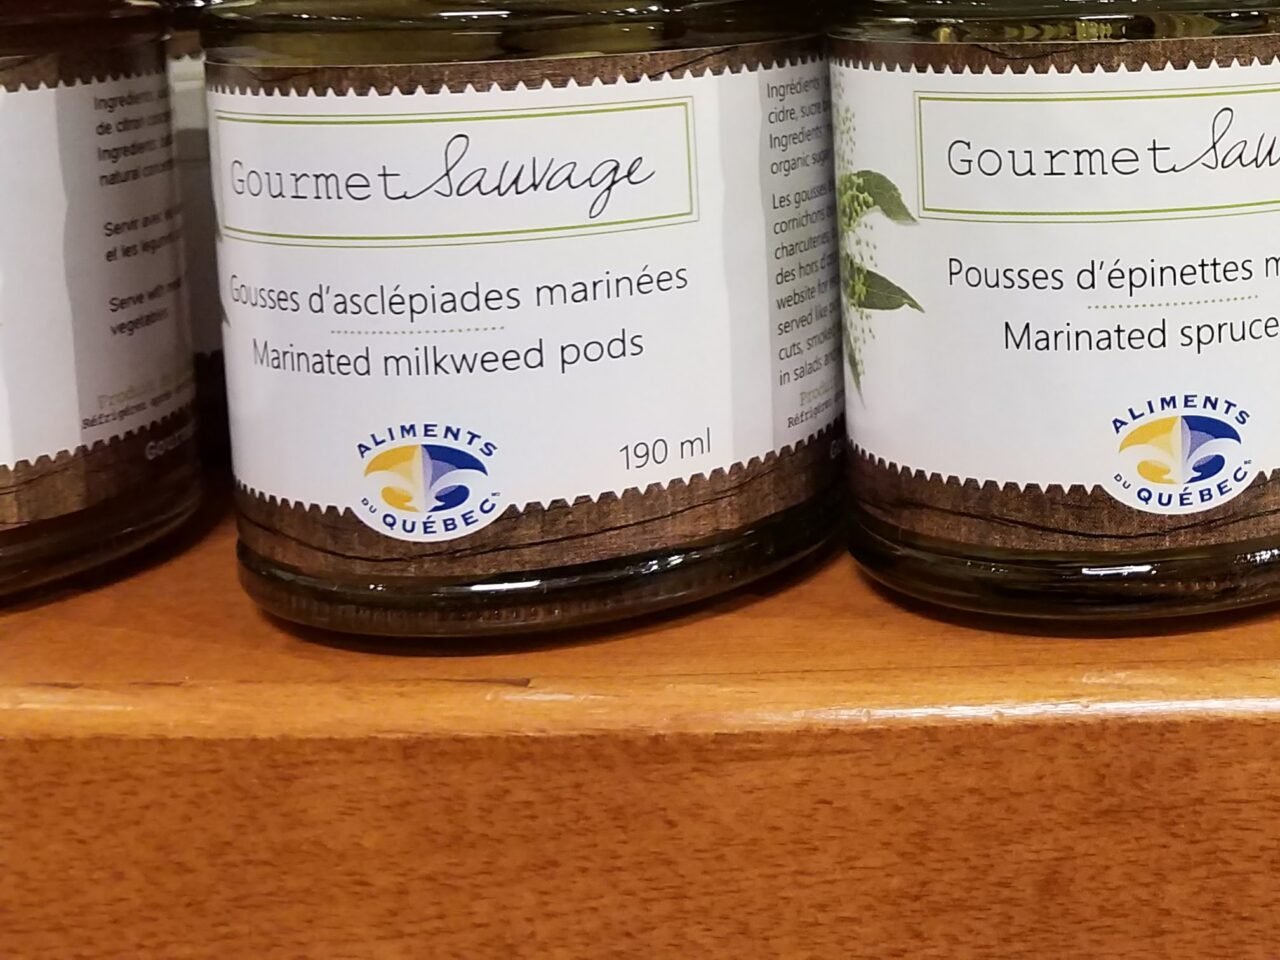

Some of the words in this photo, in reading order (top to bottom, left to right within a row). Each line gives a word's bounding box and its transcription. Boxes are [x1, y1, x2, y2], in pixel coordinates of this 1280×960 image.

[230, 159, 409, 202] Gourmet
[403, 133, 656, 219] Sauvage
[947, 137, 1179, 178] Gourmet
[772, 192, 792, 211] Les
[229, 274, 301, 314] Gousses
[308, 281, 521, 324] d'asclépiades
[535, 264, 689, 308] marinées
[948, 257, 1065, 292] Pousses
[1075, 254, 1254, 297] d'épinettes
[777, 312, 814, 337] served
[1003, 318, 1168, 353] Marinated
[1179, 309, 1280, 355] spruce
[253, 338, 371, 378] Marinated
[383, 338, 545, 378] milkweed
[559, 328, 645, 375] pods
[1111, 394, 1251, 435] ALIMENTS
[356, 423, 499, 460] ALIMENTS
[618, 437, 668, 471] 190
[679, 427, 712, 461] ml
[1136, 466, 1250, 508] QUÉBEC
[381, 496, 498, 535] QUÉBEC
